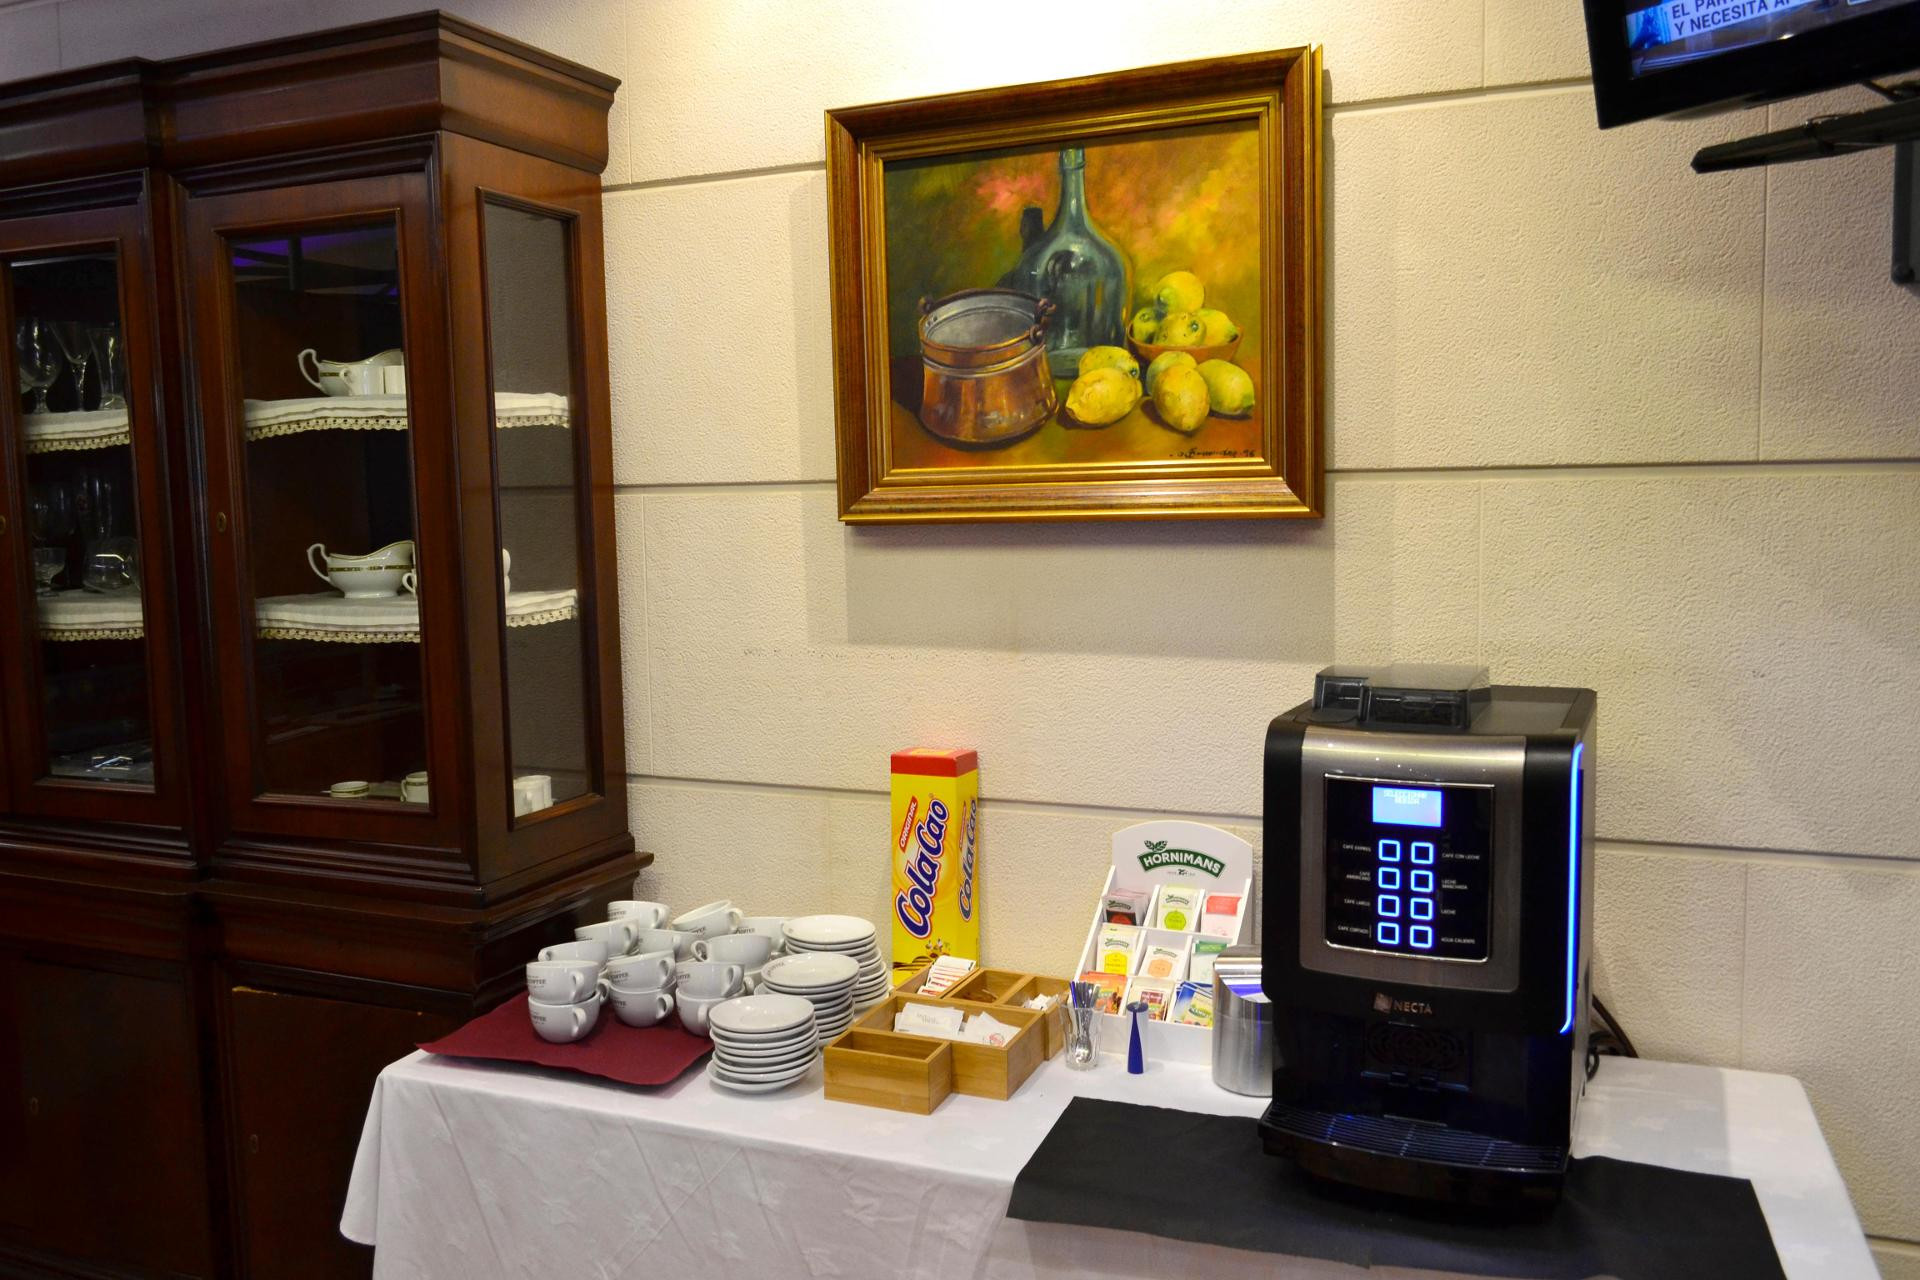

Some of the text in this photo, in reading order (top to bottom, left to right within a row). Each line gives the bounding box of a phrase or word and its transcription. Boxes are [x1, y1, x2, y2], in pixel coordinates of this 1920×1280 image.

[1672, 3, 1690, 19] EL
[1674, 21, 1685, 36] Y
[1690, 0, 1768, 32] NECESITA
[900, 801, 917, 848] ORIGINAL
[896, 798, 948, 938] ColaCao
[1143, 851, 1221, 875] HORNIMANS
[1394, 1000, 1433, 1015] NECTA
